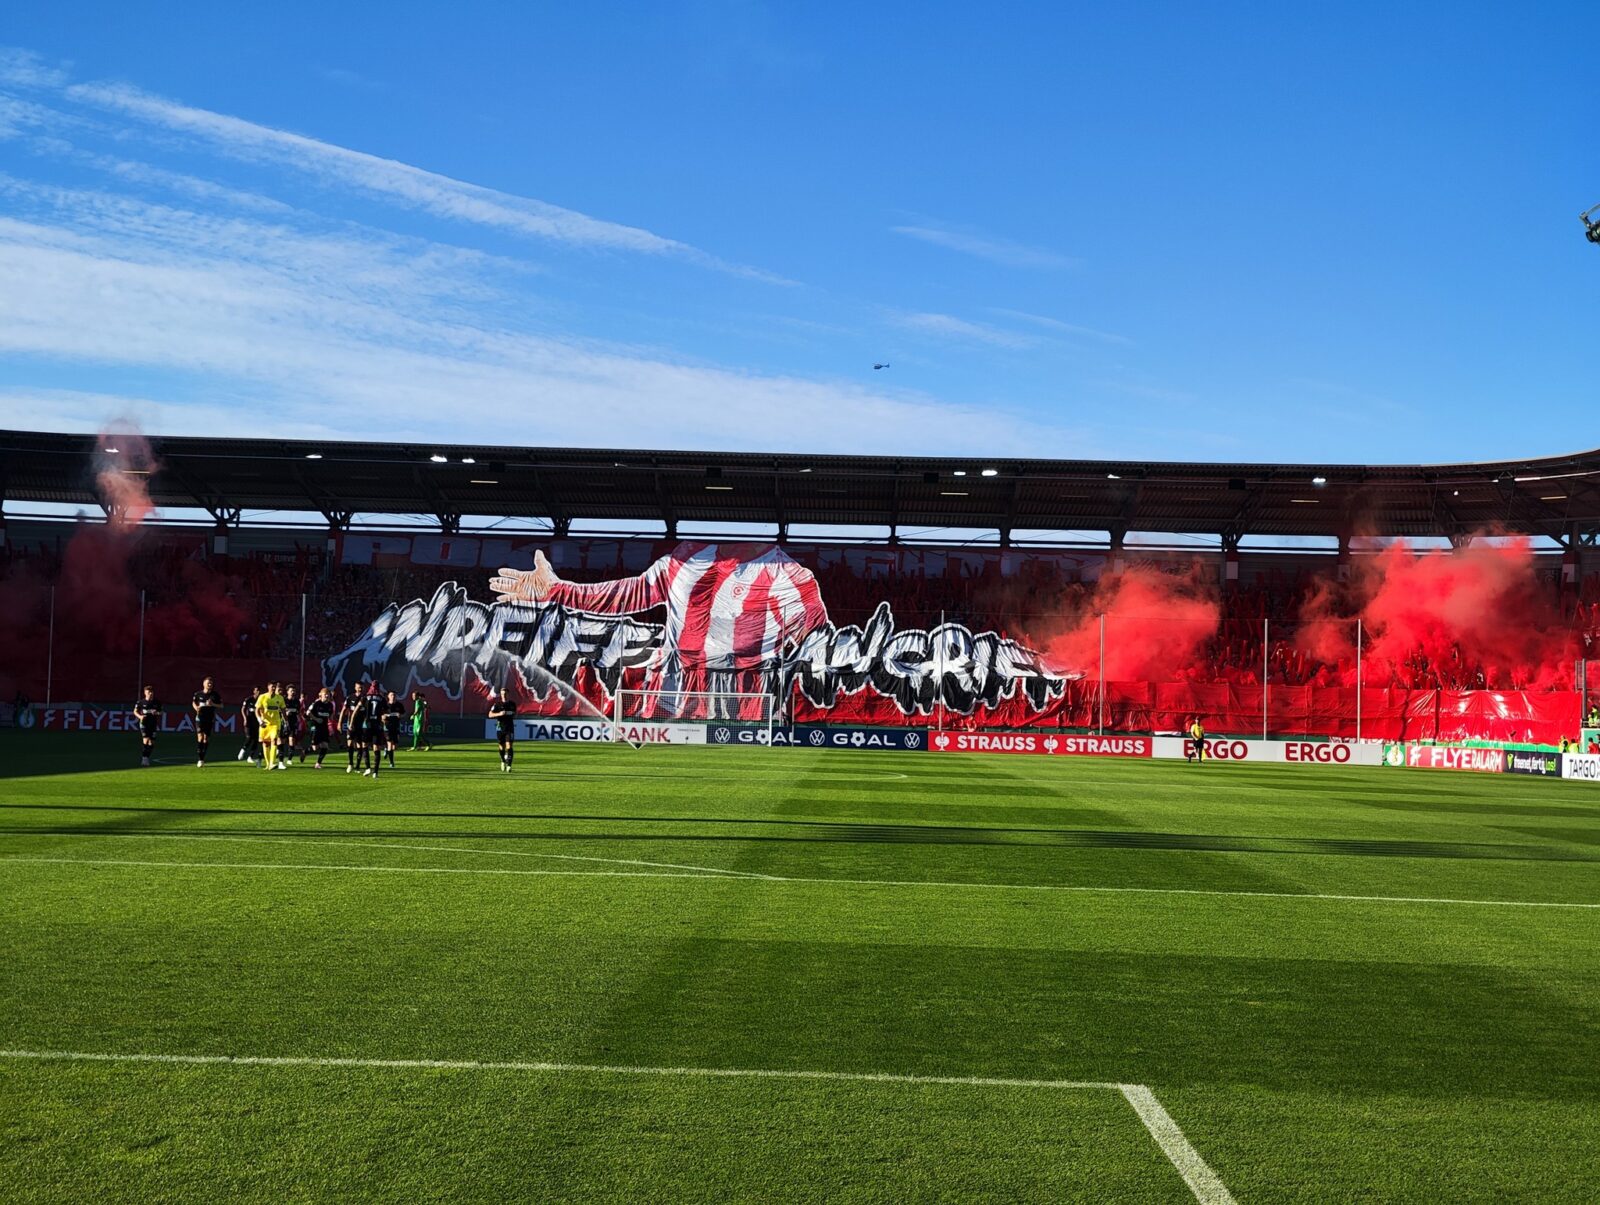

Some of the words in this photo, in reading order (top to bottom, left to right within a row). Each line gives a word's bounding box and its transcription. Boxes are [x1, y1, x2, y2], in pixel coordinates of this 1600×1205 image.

[64, 709, 236, 733] FLYERLAM
[957, 735, 1036, 751] STRAUSS
[1066, 738, 1145, 754] STRAUSS
[1183, 739, 1248, 760] ERGO
[1285, 742, 1351, 763] ERGO
[1431, 746, 1503, 772] FLYERALARM
